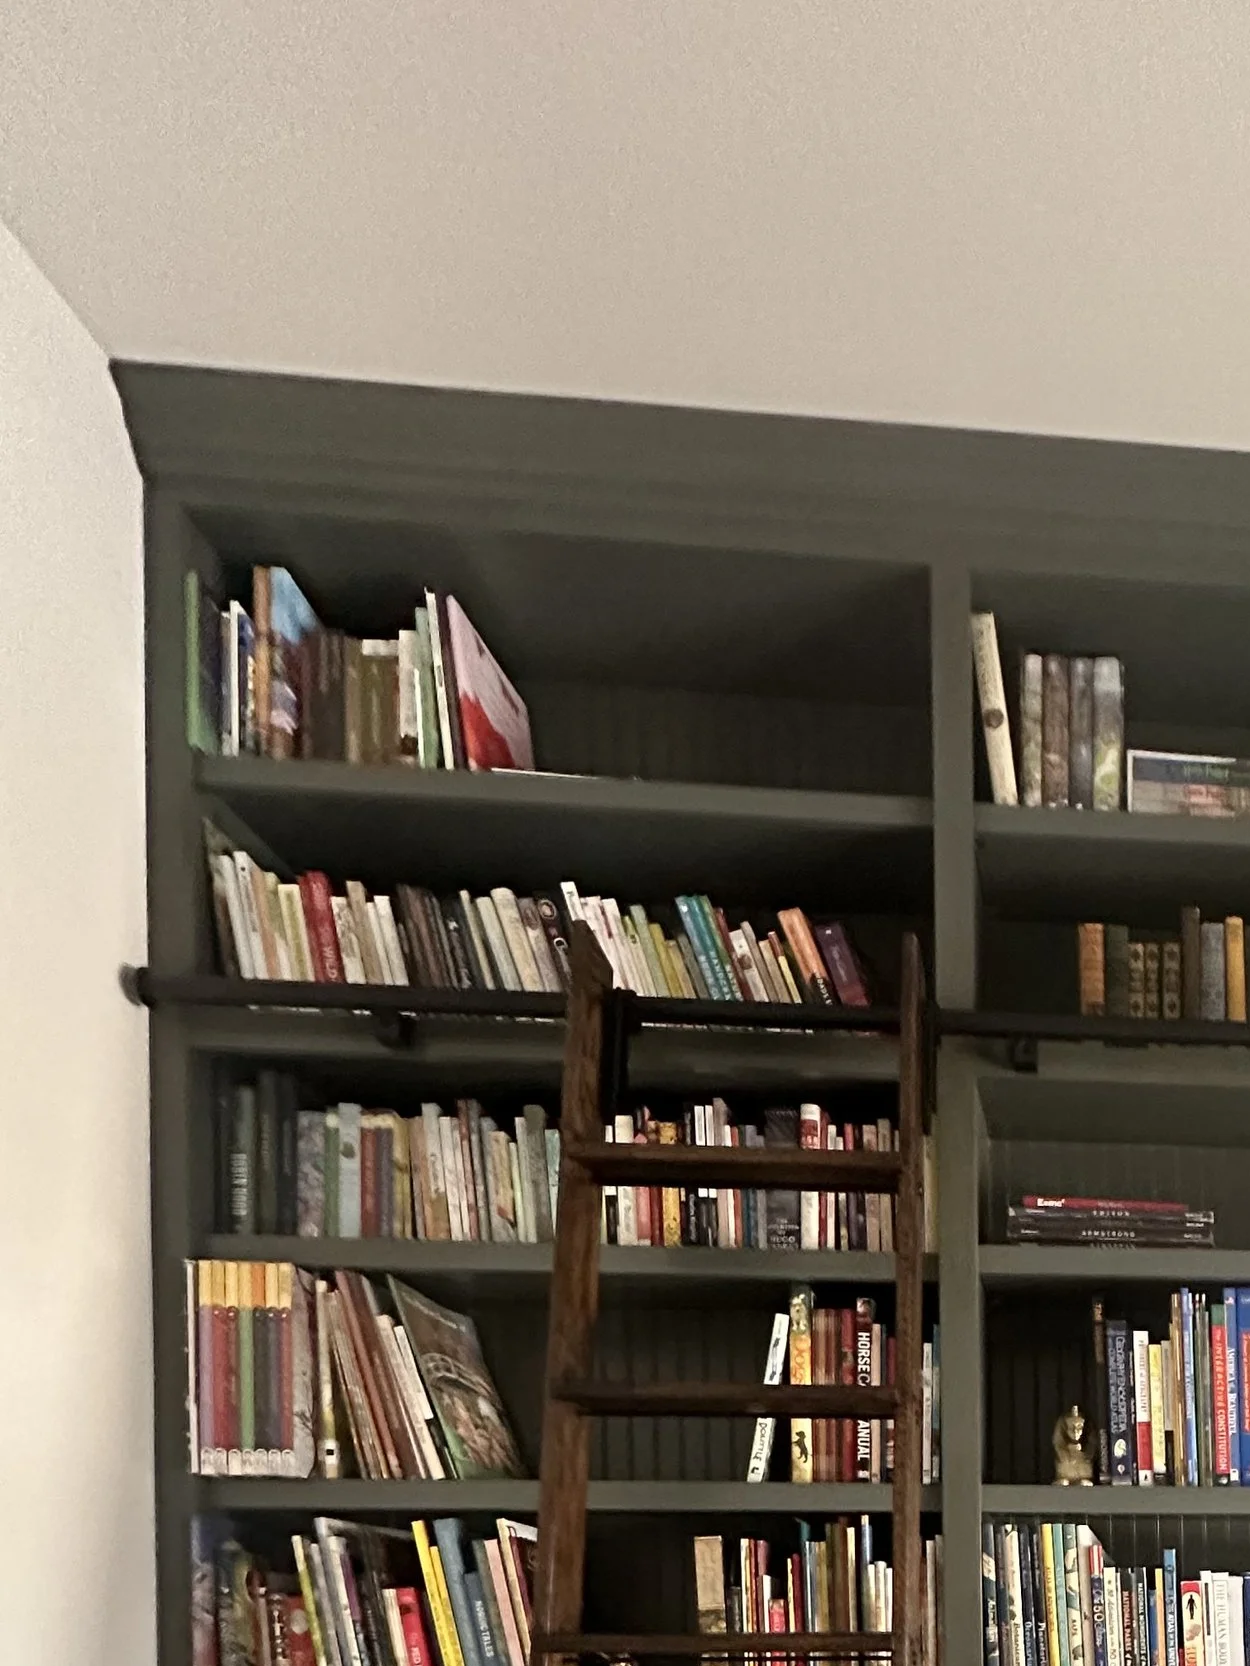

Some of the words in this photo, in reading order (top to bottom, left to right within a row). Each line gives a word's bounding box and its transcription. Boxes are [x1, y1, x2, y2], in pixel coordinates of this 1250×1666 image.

[857, 1332, 870, 1372] HORSE
[857, 1420, 870, 1461] ANUAL
[1217, 1409, 1228, 1471] CONSTITUTION
[1137, 1582, 1145, 1613] NATIONAL
[1093, 1605, 1105, 1620] 50
[1168, 1613, 1176, 1632] ATLAS
[1216, 1603, 1227, 1639] HUMAN
[411, 1647, 421, 1663] RED
[481, 1632, 495, 1657] TALES
[1109, 1648, 1118, 1659] 50
[1218, 1641, 1228, 1664] BODY
